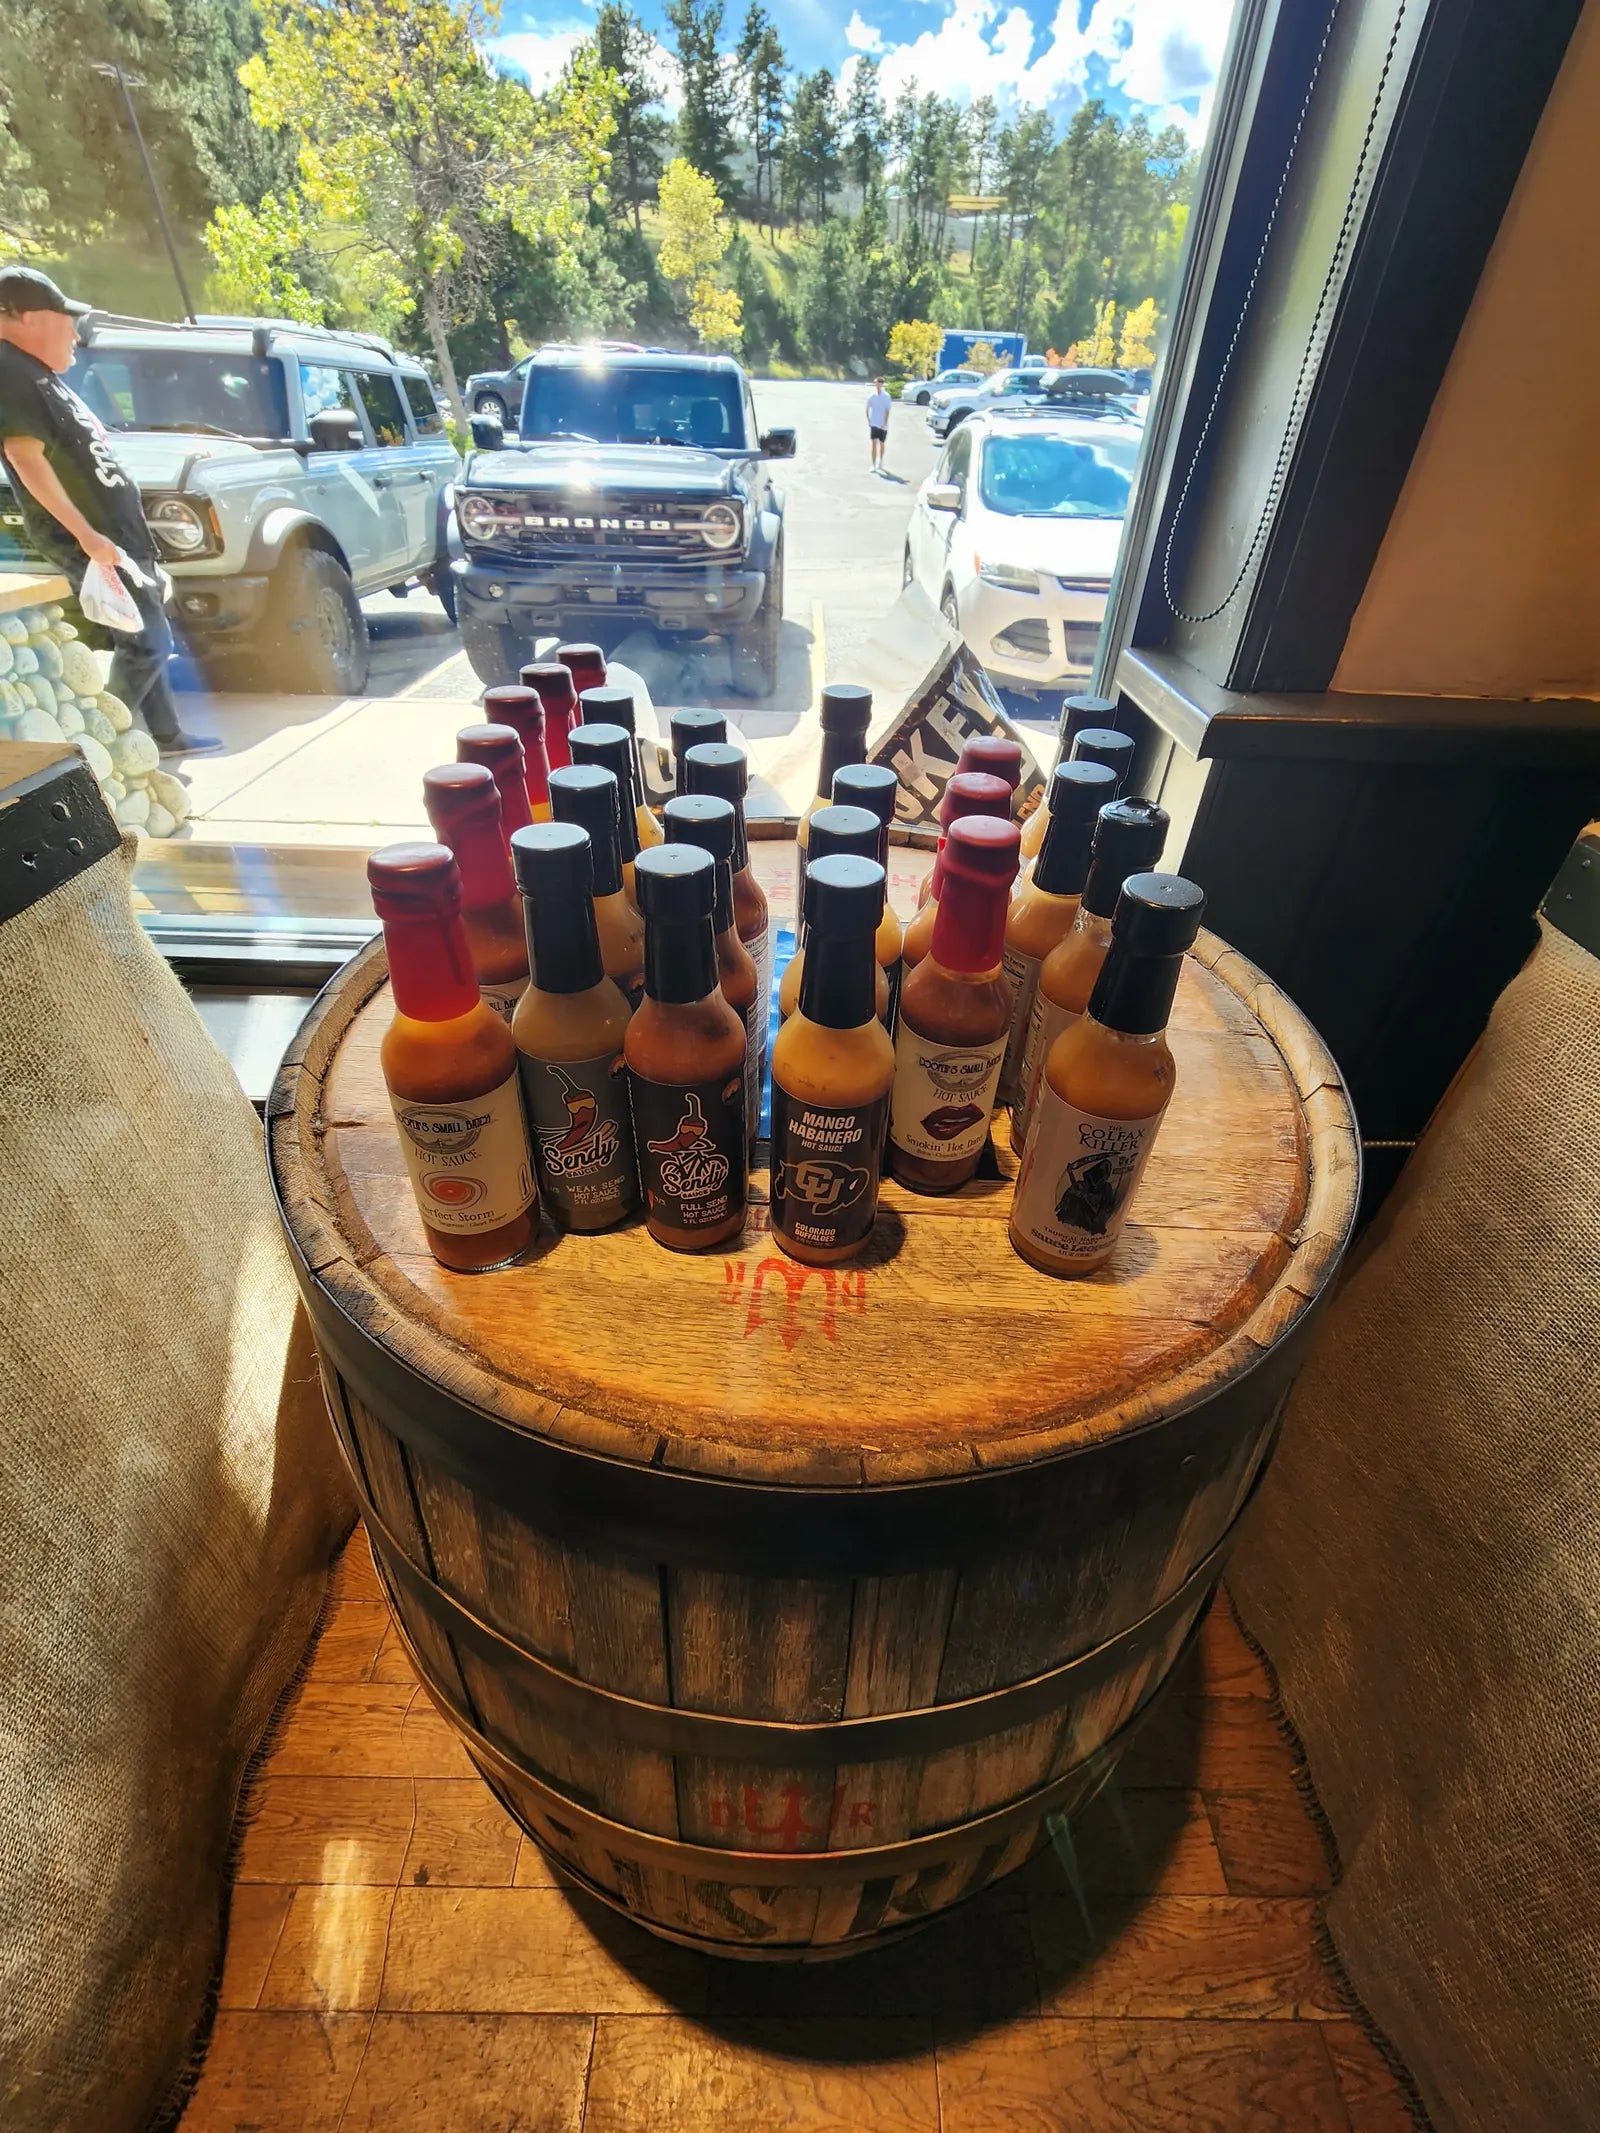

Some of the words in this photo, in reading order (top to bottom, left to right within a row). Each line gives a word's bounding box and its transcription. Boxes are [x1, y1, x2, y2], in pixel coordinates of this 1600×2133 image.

[524, 516, 671, 531] BRONCO
[960, 1062, 984, 1074] SMALL
[933, 1088, 956, 1102] HOT
[958, 1084, 988, 1103] SAUCE
[431, 1122, 463, 1134] SMALL
[465, 1113, 492, 1131] BATCH
[802, 1111, 856, 1130] MANGO
[788, 1119, 863, 1144] HABANERO
[1078, 1123, 1145, 1141] COLFAX
[801, 1140, 817, 1150] HOT
[817, 1143, 845, 1153] SAUCE
[905, 1134, 944, 1152] Smokin'
[947, 1142, 964, 1152] Hot
[1079, 1134, 1139, 1152] KILLER
[415, 1147, 437, 1165] HOT
[441, 1148, 482, 1167] SAUCE
[542, 1132, 620, 1176] Sendy
[565, 1165, 599, 1179] SAUCE
[662, 1163, 728, 1197] Sendy
[565, 1184, 597, 1193] WEAK
[601, 1175, 625, 1190] SEND
[574, 1192, 590, 1200] HOT
[592, 1185, 620, 1199] SAUCE
[680, 1188, 712, 1200] SAUCE
[680, 1203, 703, 1211] FULL
[706, 1195, 728, 1209] SEND
[458, 1209, 495, 1222] Storm
[701, 1204, 727, 1217] SAUCE
[794, 1228, 835, 1242] BUFFALOES
[795, 1221, 836, 1236] COLORADO
[1044, 1226, 1077, 1241] TROPICAL
[1031, 1228, 1069, 1250] Sauce
[850, 1802, 876, 1829] R
